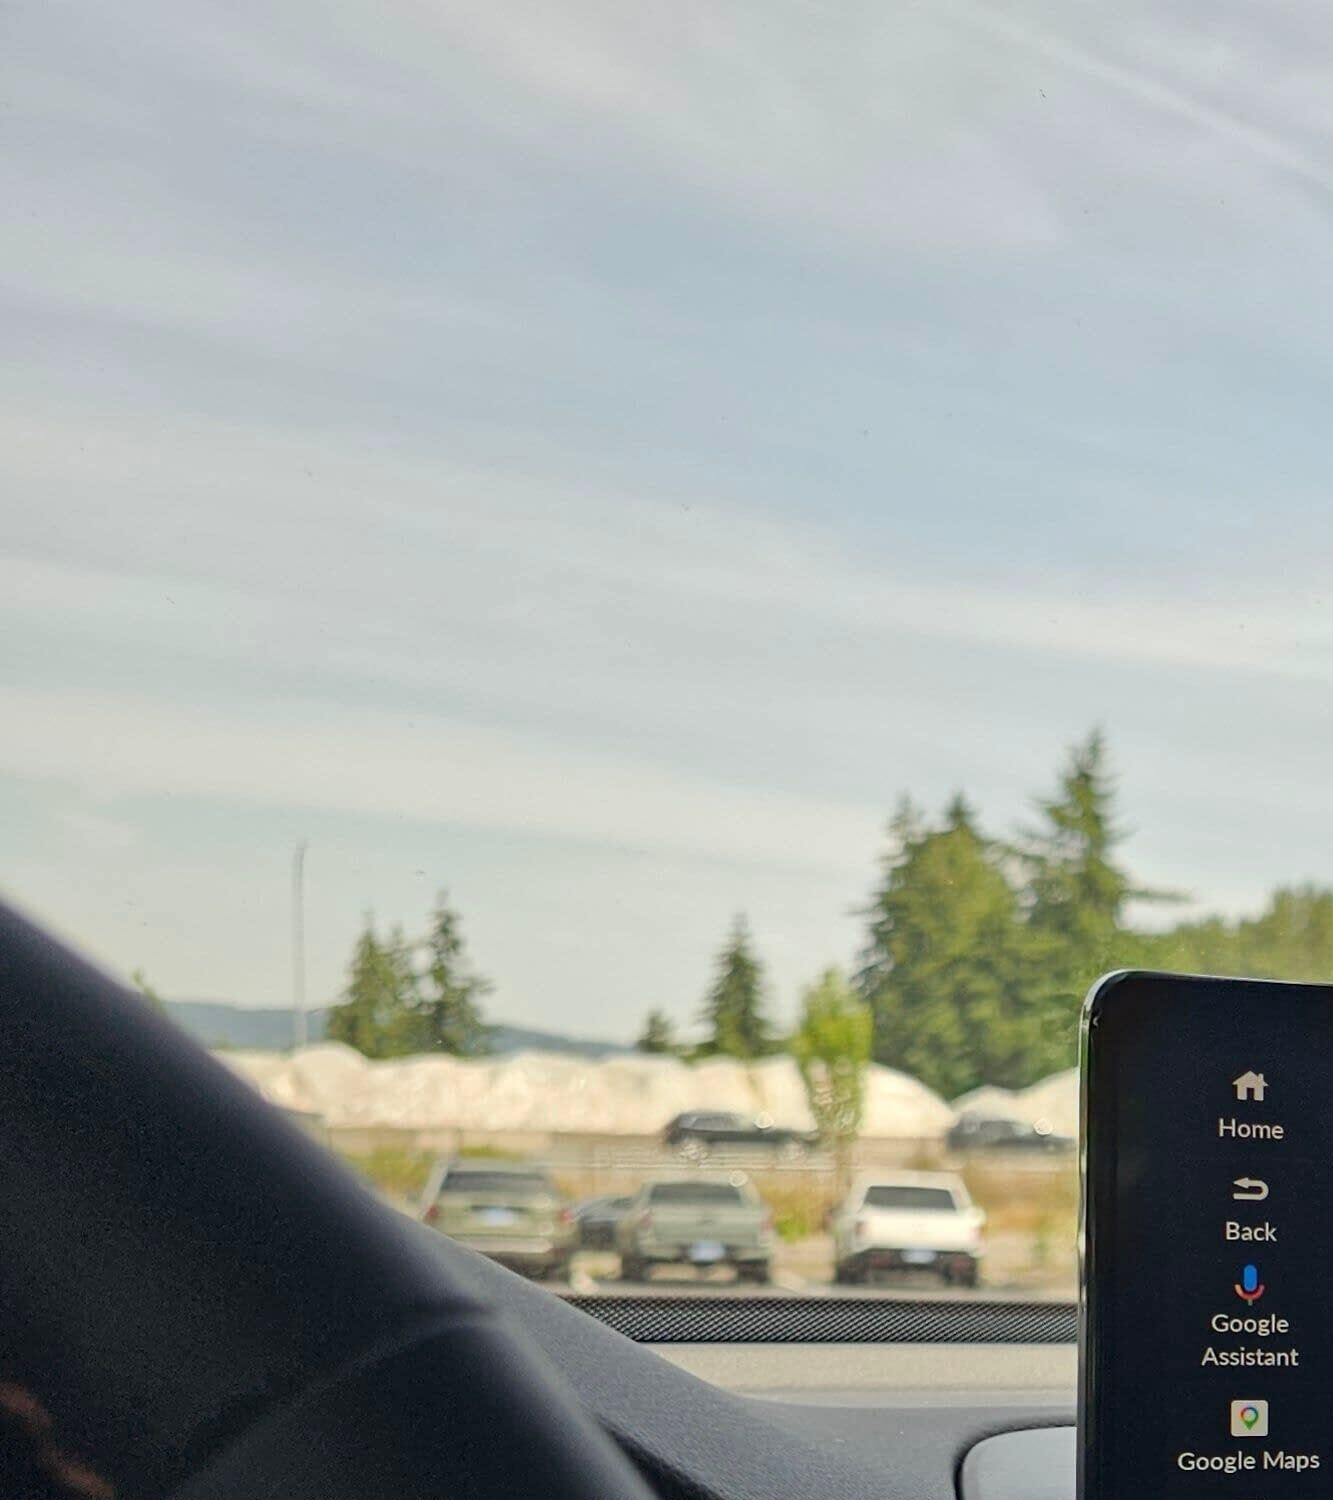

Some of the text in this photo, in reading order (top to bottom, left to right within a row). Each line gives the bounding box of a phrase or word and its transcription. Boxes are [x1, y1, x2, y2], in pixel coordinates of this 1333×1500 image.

[1219, 1118, 1283, 1139] Home
[1226, 1222, 1276, 1241] Back
[1212, 1314, 1289, 1336] Google
[1202, 1347, 1298, 1366] Assistant
[1178, 1451, 1320, 1473] Google Maps
